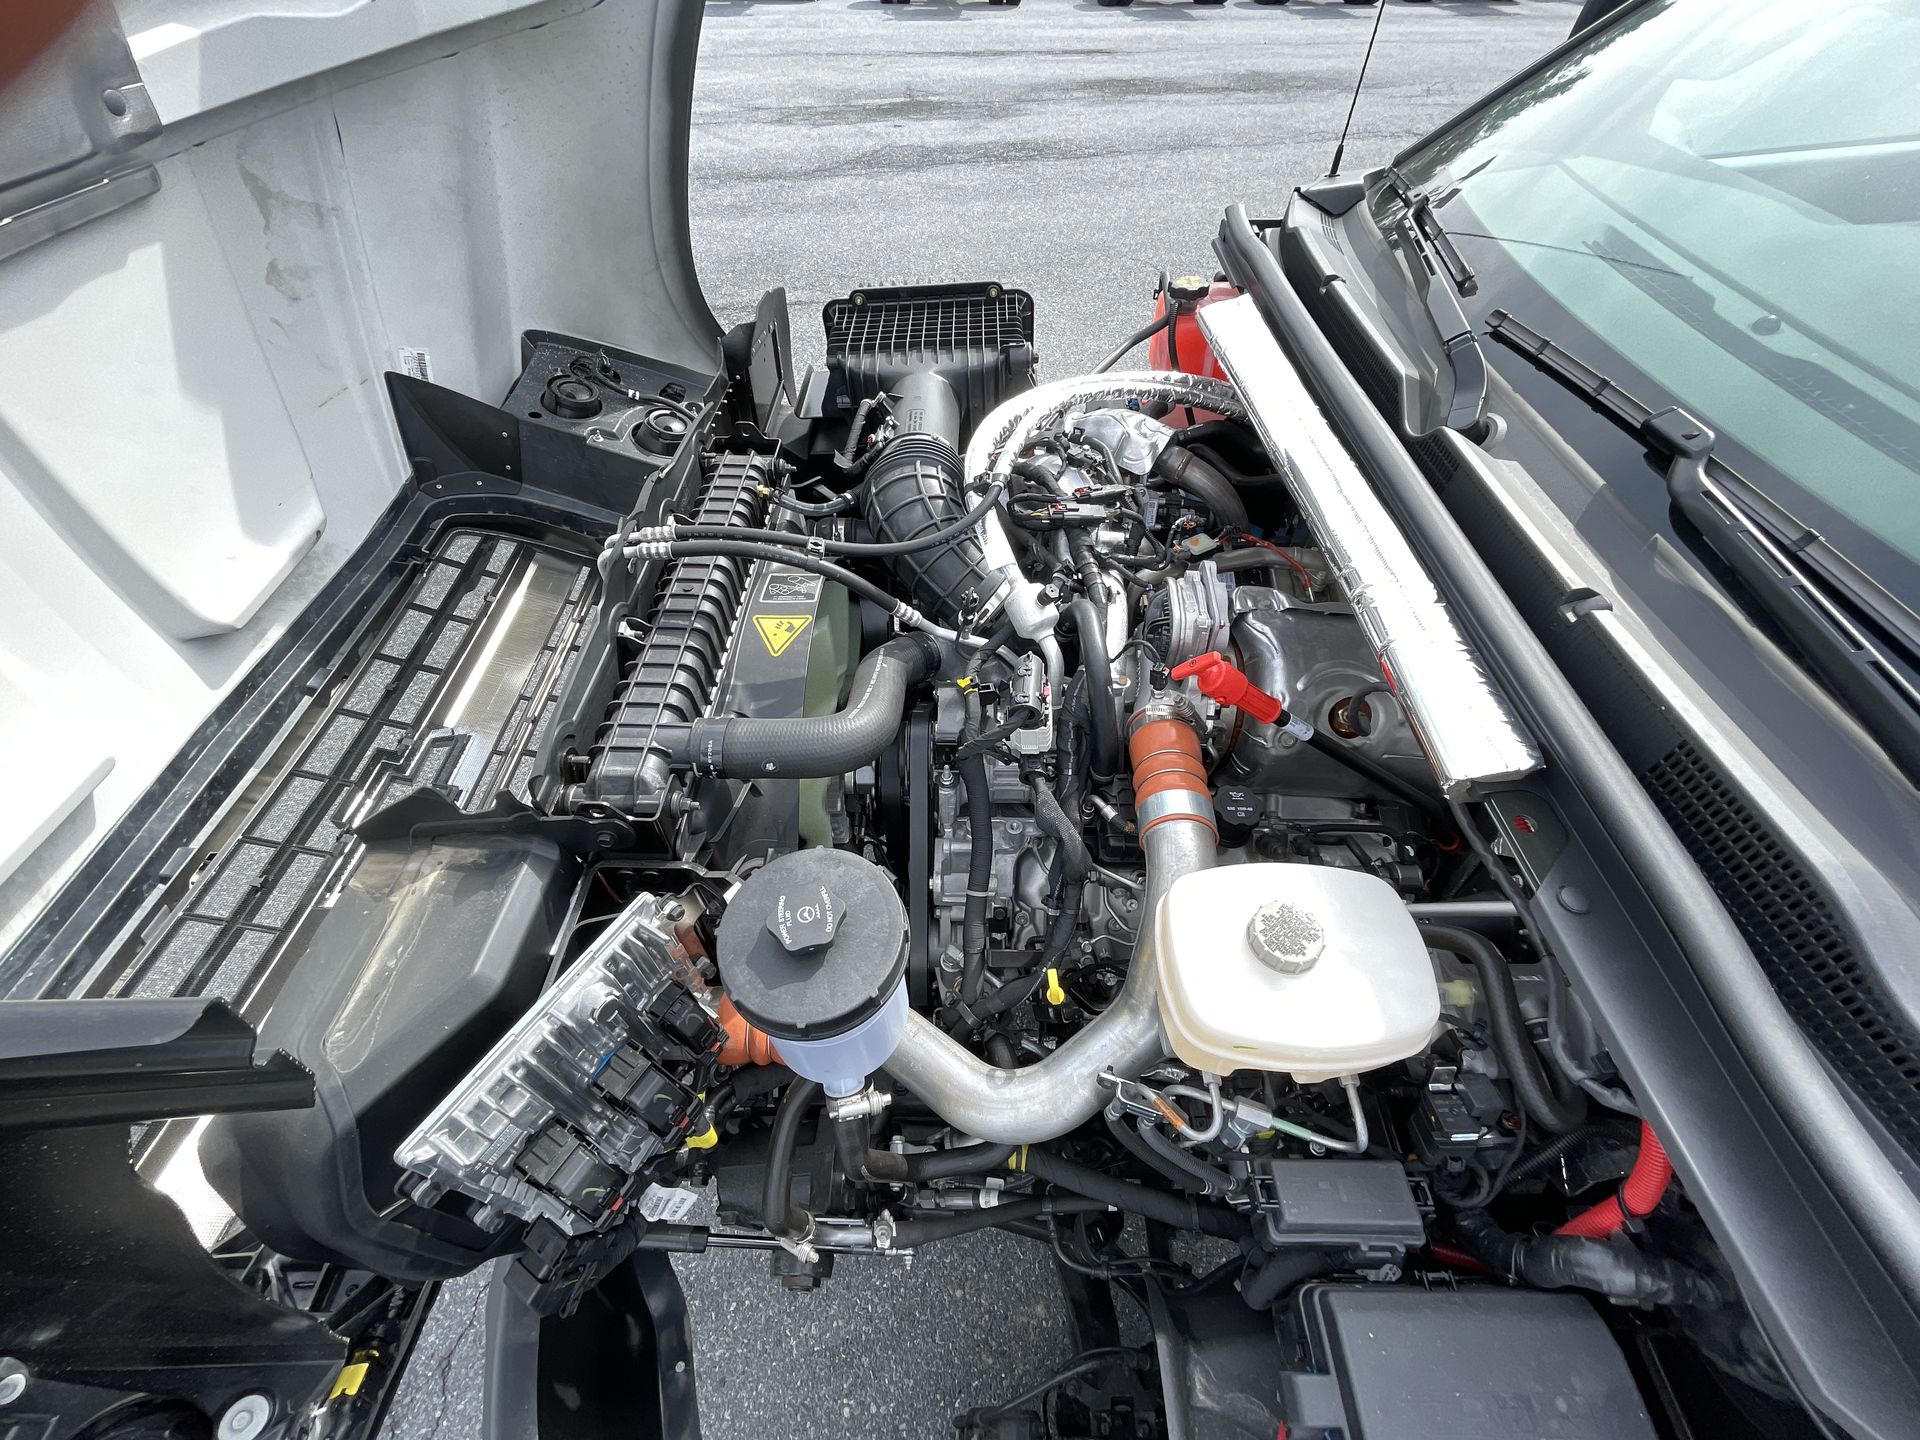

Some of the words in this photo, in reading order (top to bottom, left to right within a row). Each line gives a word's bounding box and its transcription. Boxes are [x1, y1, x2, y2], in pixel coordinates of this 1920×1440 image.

[777, 895, 786, 923] STEERING
[819, 885, 831, 911] OVERFILL
[779, 923, 793, 945] POWER
[825, 922, 833, 933] DO
